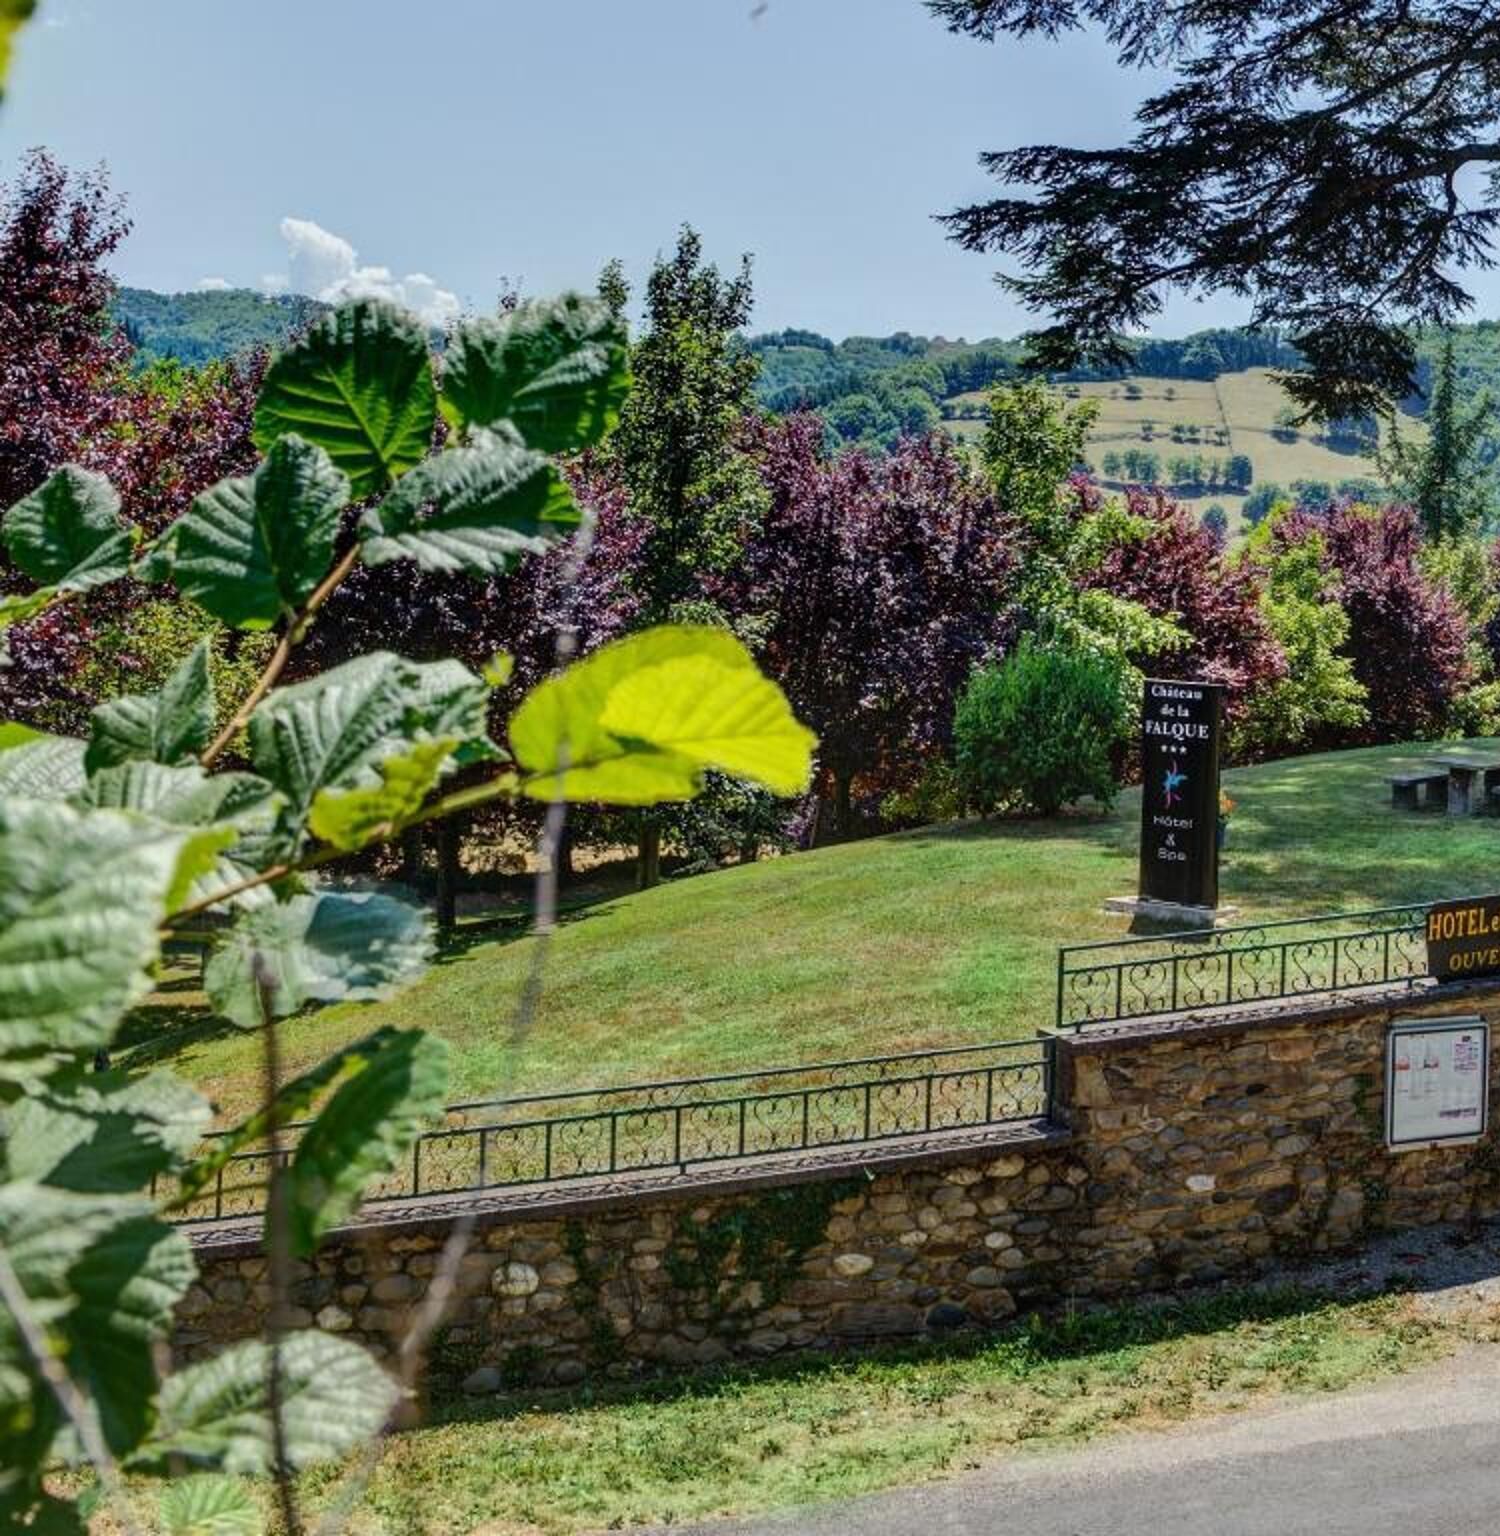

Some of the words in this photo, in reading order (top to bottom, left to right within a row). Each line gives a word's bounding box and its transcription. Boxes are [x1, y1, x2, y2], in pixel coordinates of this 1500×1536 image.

[1151, 684, 1203, 699] Château
[1161, 703, 1175, 716] de
[1177, 704, 1189, 717] la
[1145, 719, 1208, 740] FALQUE
[1153, 815, 1193, 829] Hôtel
[1165, 833, 1176, 846] &
[1157, 847, 1187, 861] Spa
[1428, 907, 1489, 941] HOTEL
